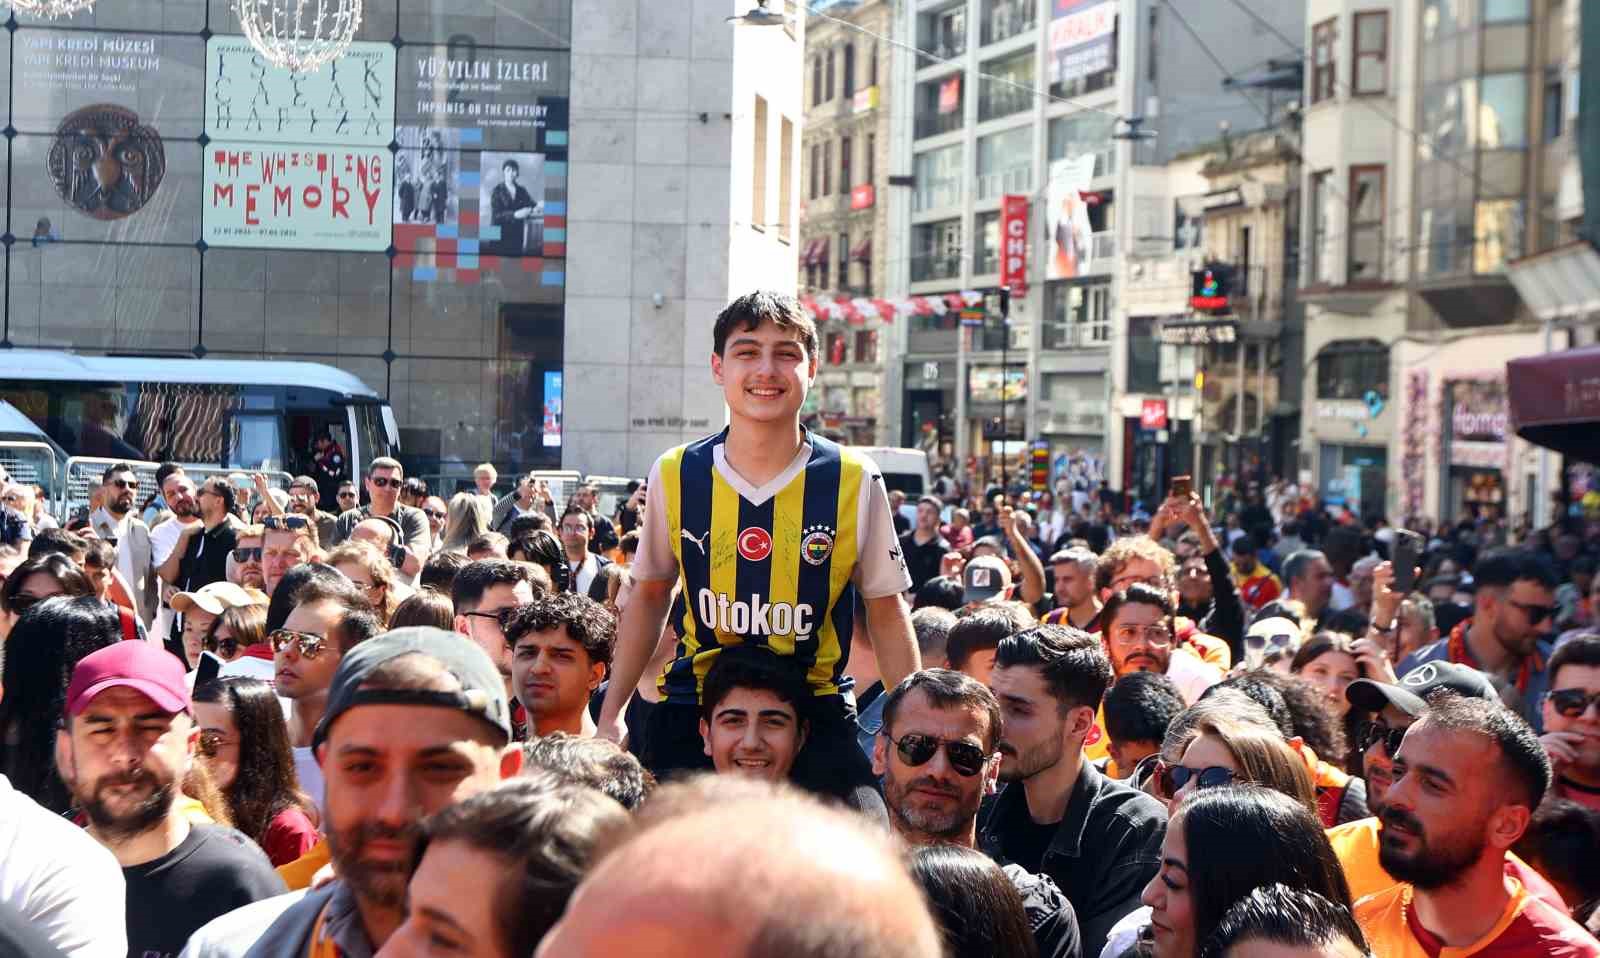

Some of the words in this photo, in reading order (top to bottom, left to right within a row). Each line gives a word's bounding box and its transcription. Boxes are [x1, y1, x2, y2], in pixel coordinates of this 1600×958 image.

[24, 37, 52, 49] YAPI
[58, 37, 97, 51] KREDİ
[103, 36, 155, 52] MÜZESİ
[100, 55, 160, 71] MUSEUM
[418, 56, 490, 79] YÜZYILIN
[497, 59, 548, 81] İZLERİ
[469, 103, 481, 115] ON
[485, 103, 501, 116] THE
[506, 104, 548, 117] CENTURY
[214, 150, 252, 177] THE
[261, 151, 381, 190] WHISTLING
[213, 184, 380, 225] MEMORY
[1007, 219, 1025, 274] CHP
[698, 588, 813, 641] Otokoç
